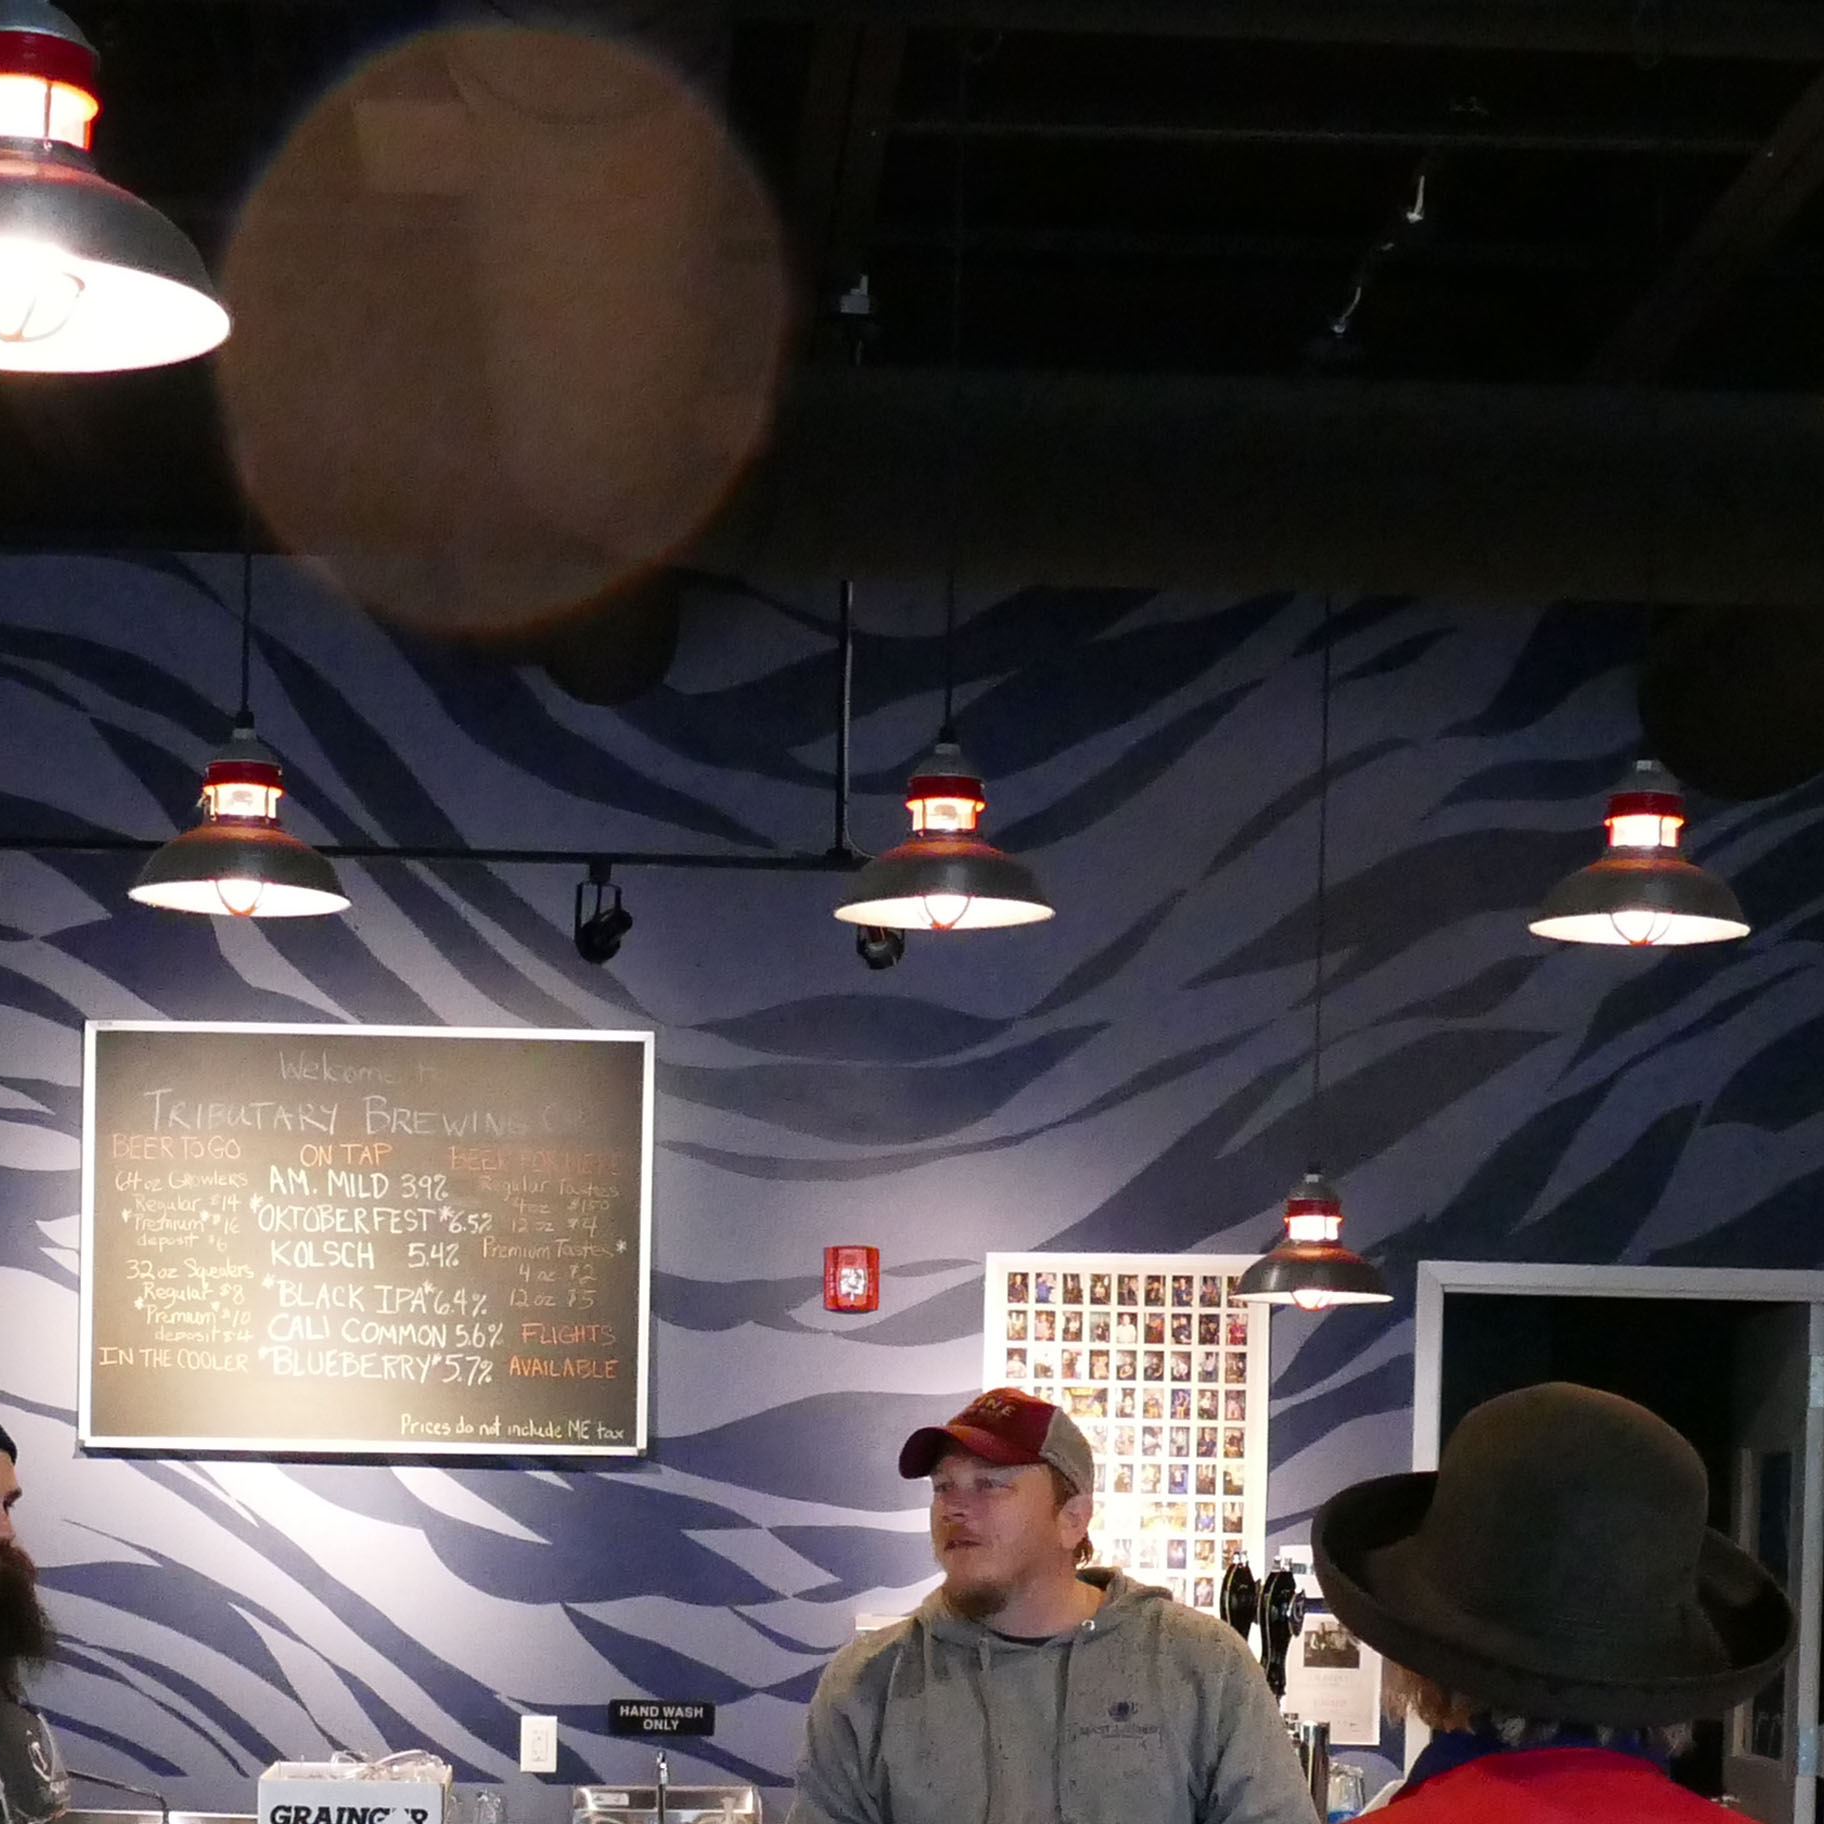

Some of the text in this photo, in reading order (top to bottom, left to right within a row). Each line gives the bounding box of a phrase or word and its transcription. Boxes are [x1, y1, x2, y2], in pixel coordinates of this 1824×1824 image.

[144, 1088, 338, 1136] TRIBUTARY
[112, 1133, 174, 1159] BEER
[207, 1135, 241, 1159] GO
[300, 1142, 393, 1167] ON TAP
[115, 1170, 142, 1191] 64
[144, 1179, 162, 1191] oz
[269, 1165, 317, 1195] AM.
[327, 1168, 390, 1199] MILD
[133, 1194, 201, 1219] Regular
[258, 1204, 434, 1234] OKTOBERFEST
[271, 1240, 375, 1270] KOLSCH
[126, 1260, 155, 1279] 32
[158, 1270, 178, 1279] oz
[143, 1281, 212, 1309] Regular
[276, 1280, 364, 1312] BLACK
[374, 1284, 426, 1314] IPA
[509, 1288, 530, 1308] 12
[267, 1313, 330, 1342] CALI
[342, 1318, 446, 1347] COMMON
[520, 1322, 616, 1347] FLIGHTS
[99, 1347, 248, 1372] IN THE COOLER
[270, 1346, 430, 1384] BLUEBERRY
[508, 1355, 618, 1379] AVAILABLE
[400, 1413, 624, 1440] Prices do not include ME tax
[619, 1705, 704, 1718] HAND WASH
[643, 1719, 679, 1730] ONLY
